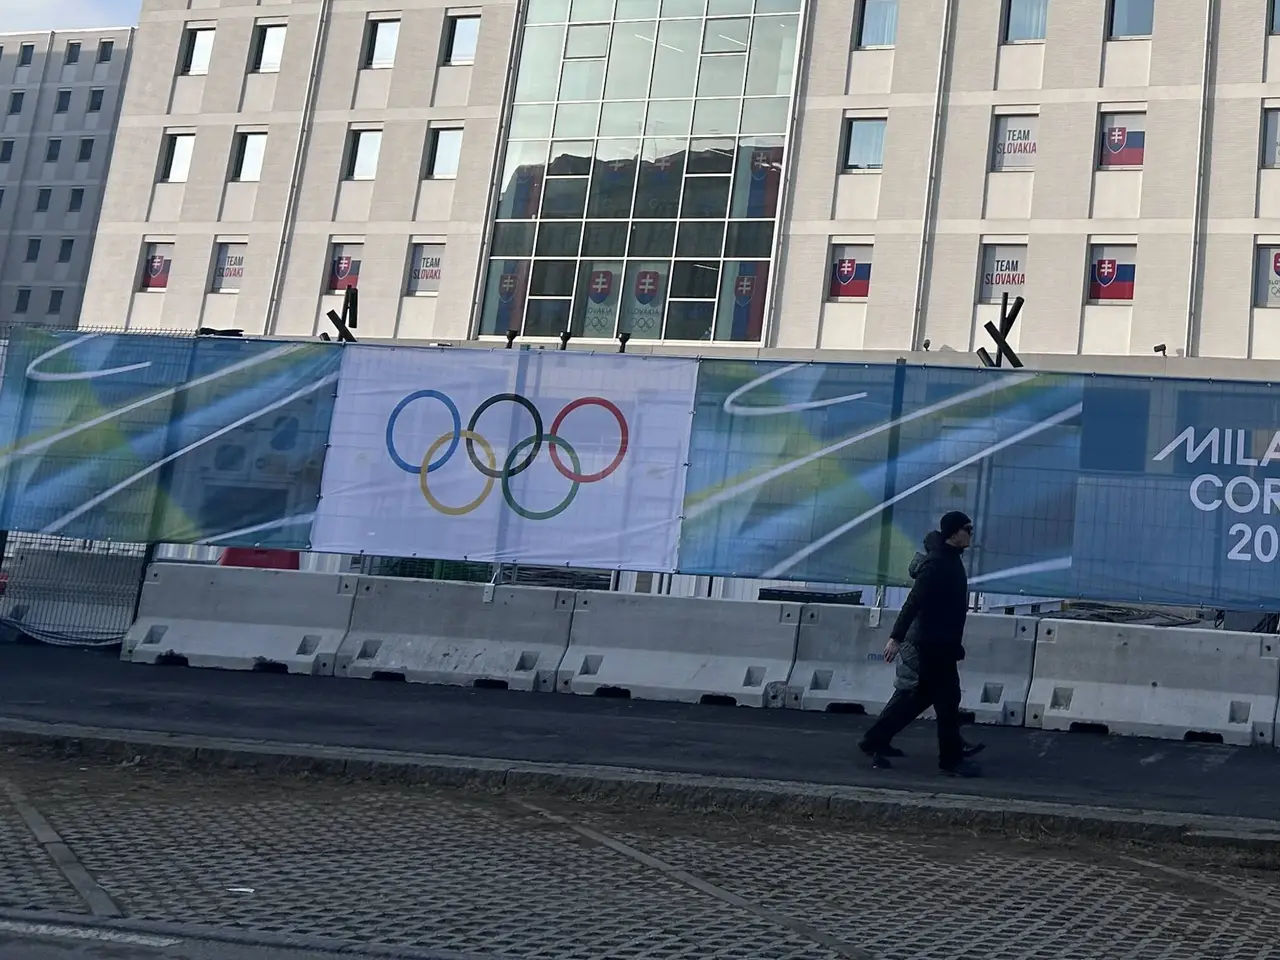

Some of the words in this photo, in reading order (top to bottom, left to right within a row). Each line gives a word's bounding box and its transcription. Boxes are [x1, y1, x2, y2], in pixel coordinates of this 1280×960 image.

[1007, 129, 1031, 141] TEAM
[997, 142, 1037, 154] SLOVAKIA
[227, 256, 244, 266] TEAM
[421, 257, 441, 268] TEAM
[995, 259, 1019, 272] TEAM
[217, 267, 244, 278] SLOVAKI
[413, 269, 441, 280] SLOVAKI
[985, 272, 1026, 286] SLOVAKIA
